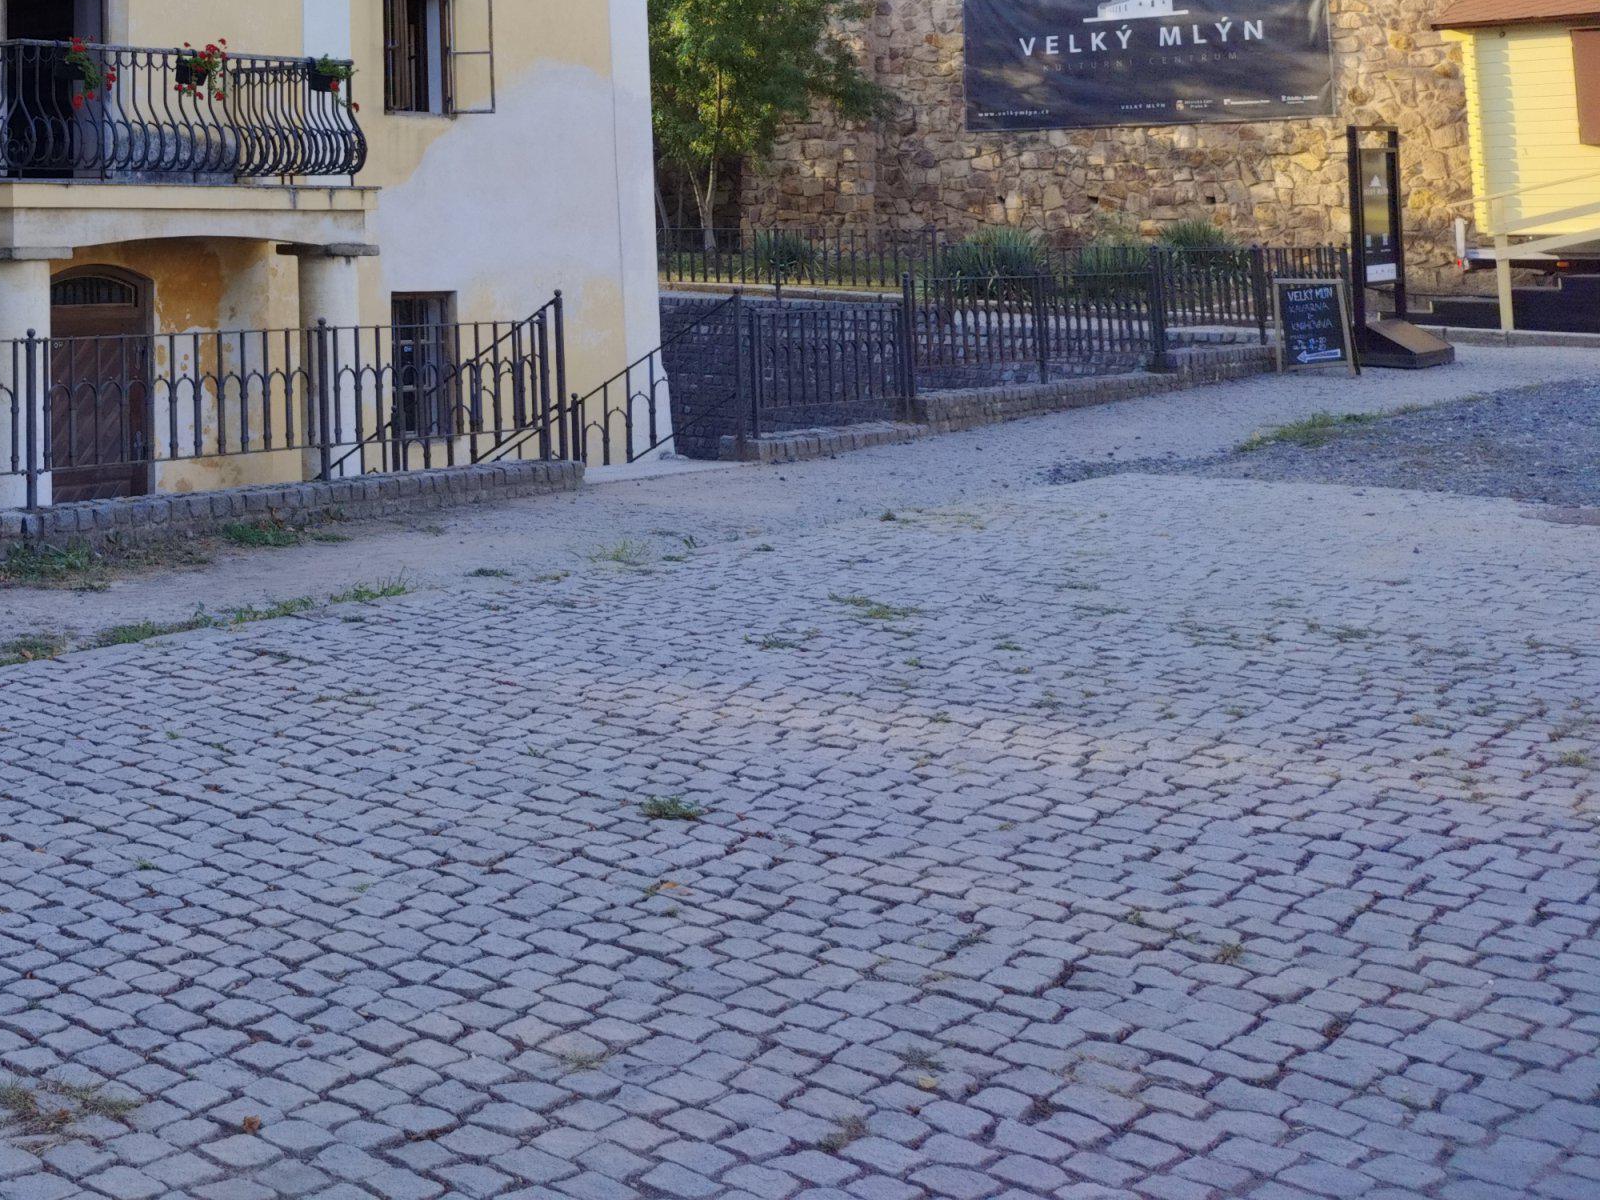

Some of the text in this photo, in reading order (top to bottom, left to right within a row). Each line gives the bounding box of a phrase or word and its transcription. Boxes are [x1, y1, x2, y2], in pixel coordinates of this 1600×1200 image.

[1018, 16, 1264, 57] VELKÝ MLÝN
[1148, 52, 1239, 66] CENTRUM
